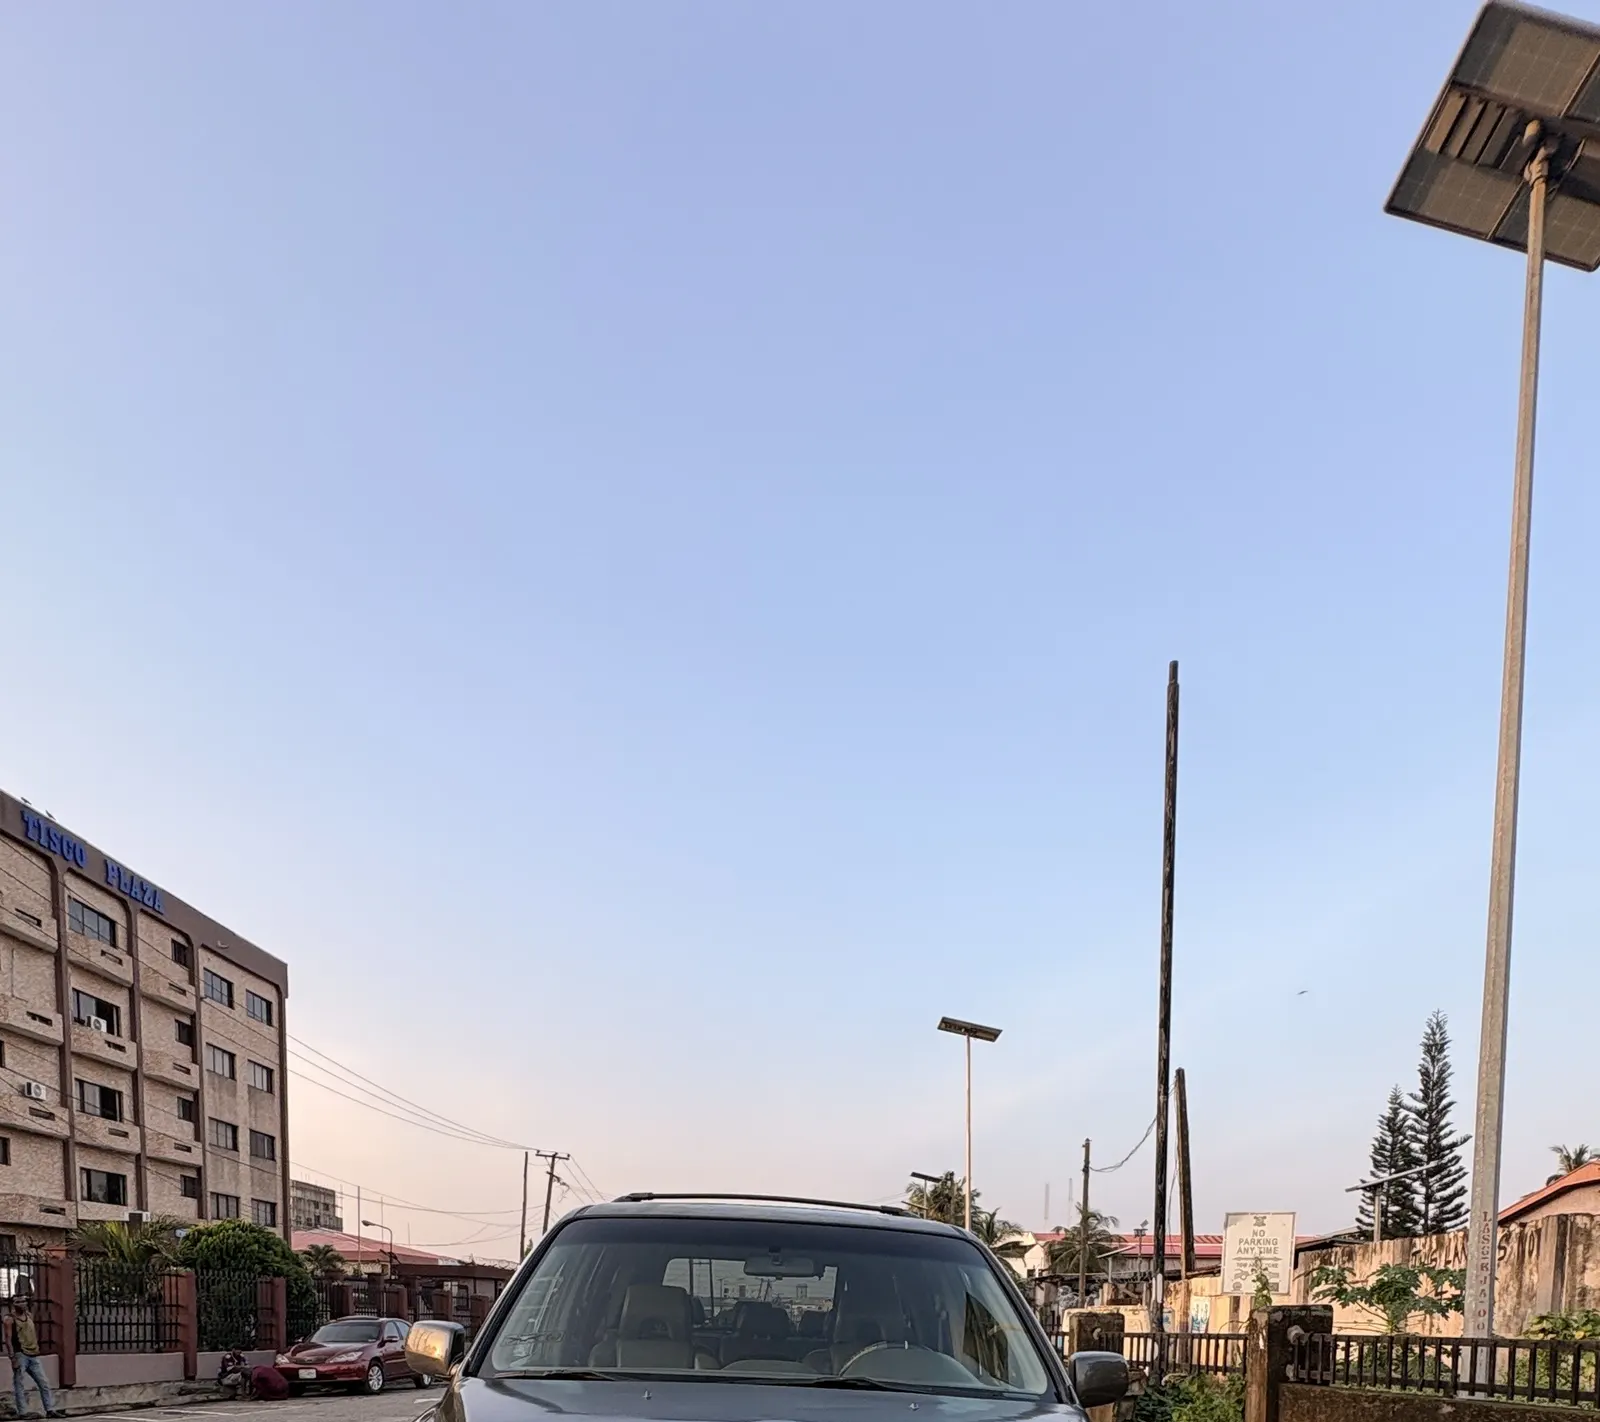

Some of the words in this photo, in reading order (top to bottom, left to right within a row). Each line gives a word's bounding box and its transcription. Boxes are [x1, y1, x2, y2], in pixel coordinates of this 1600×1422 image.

[20, 809, 87, 869] TISCO
[104, 858, 165, 916] PLAZA
[1251, 1229, 1266, 1238] NO
[1238, 1238, 1279, 1246] PARKING
[1236, 1246, 1256, 1255] ANY
[1257, 1246, 1280, 1255] TIME
